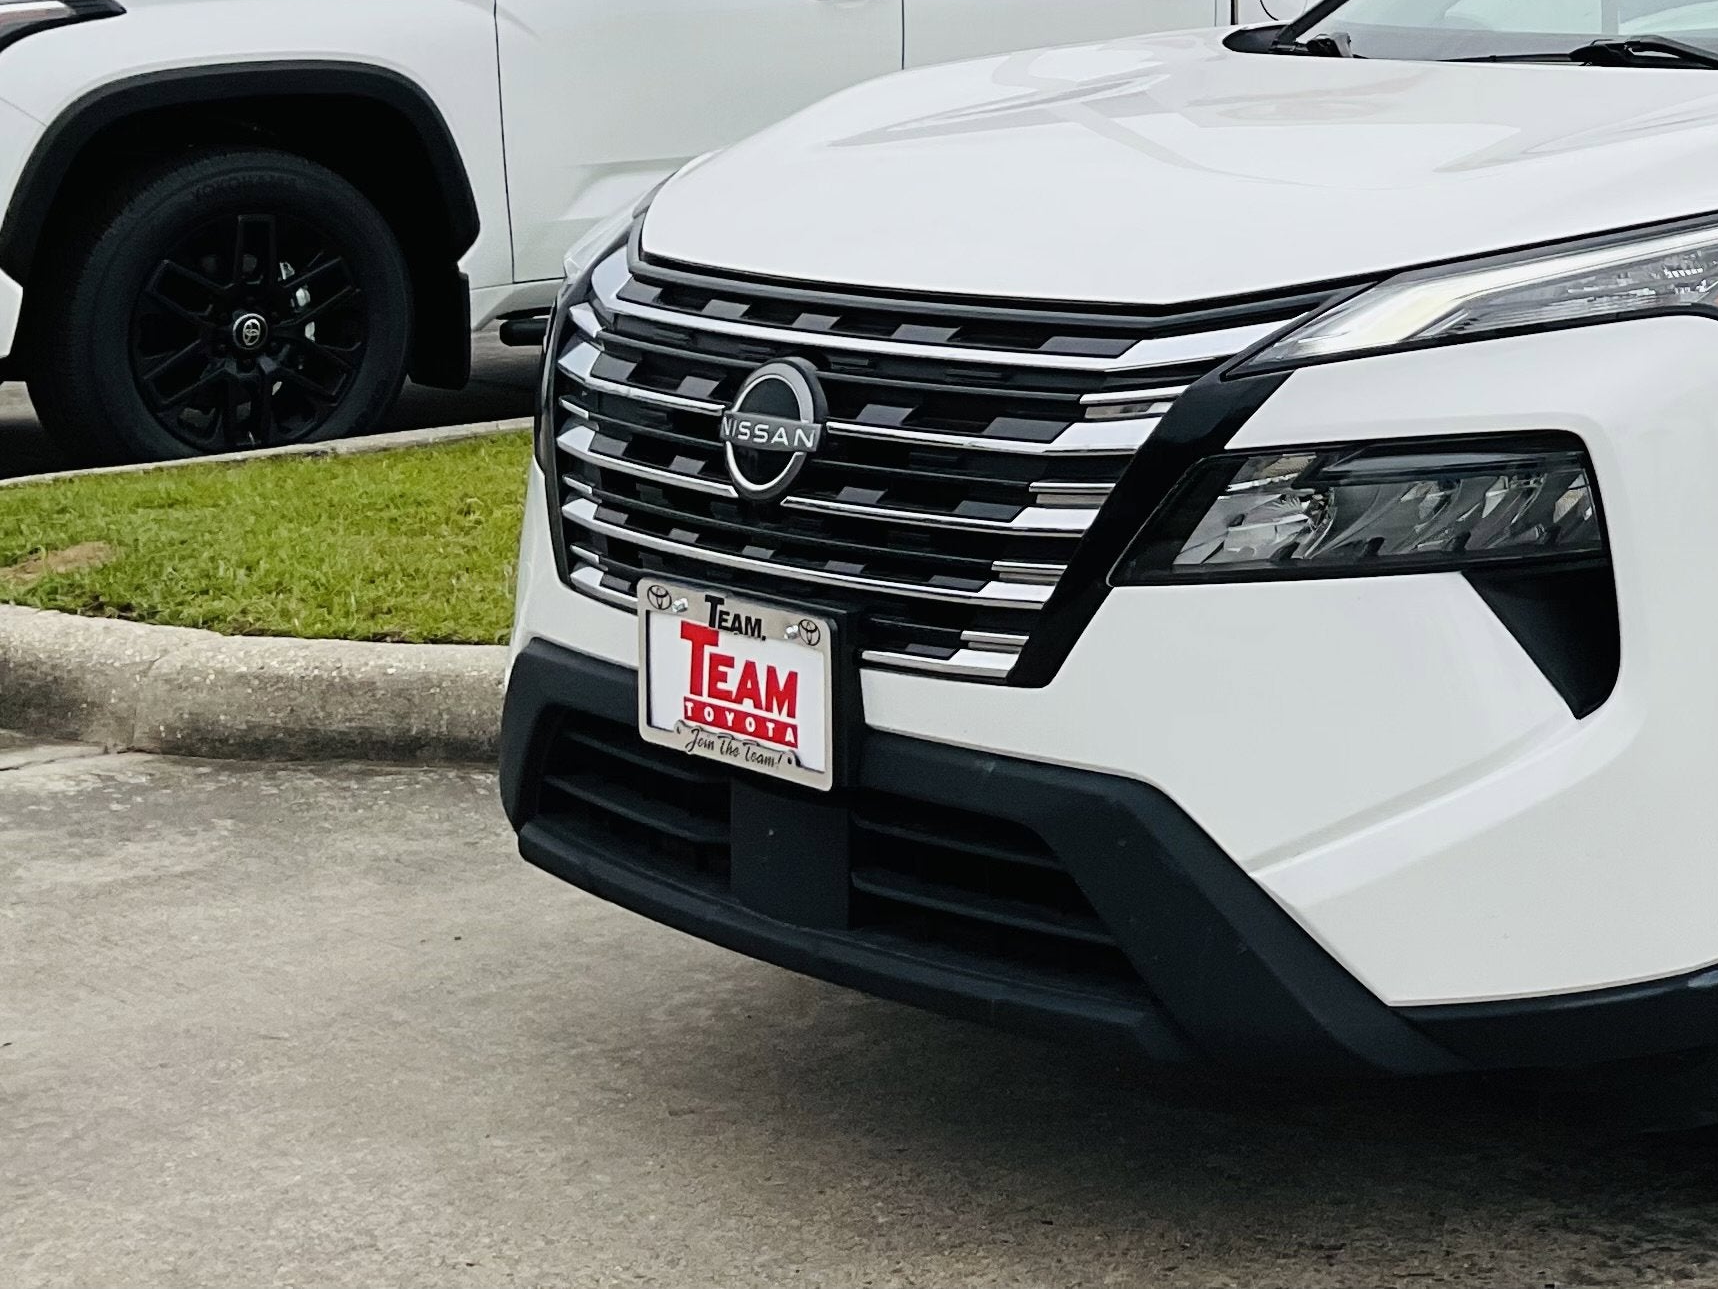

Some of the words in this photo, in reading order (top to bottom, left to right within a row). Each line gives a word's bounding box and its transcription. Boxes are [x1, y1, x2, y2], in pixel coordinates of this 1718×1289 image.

[721, 415, 816, 449] NISSAN
[680, 619, 798, 719] TEAM
[685, 700, 796, 745] TOYOTA
[685, 727, 715, 753] Join
[717, 733, 741, 758] The
[742, 741, 783, 769] Team!
